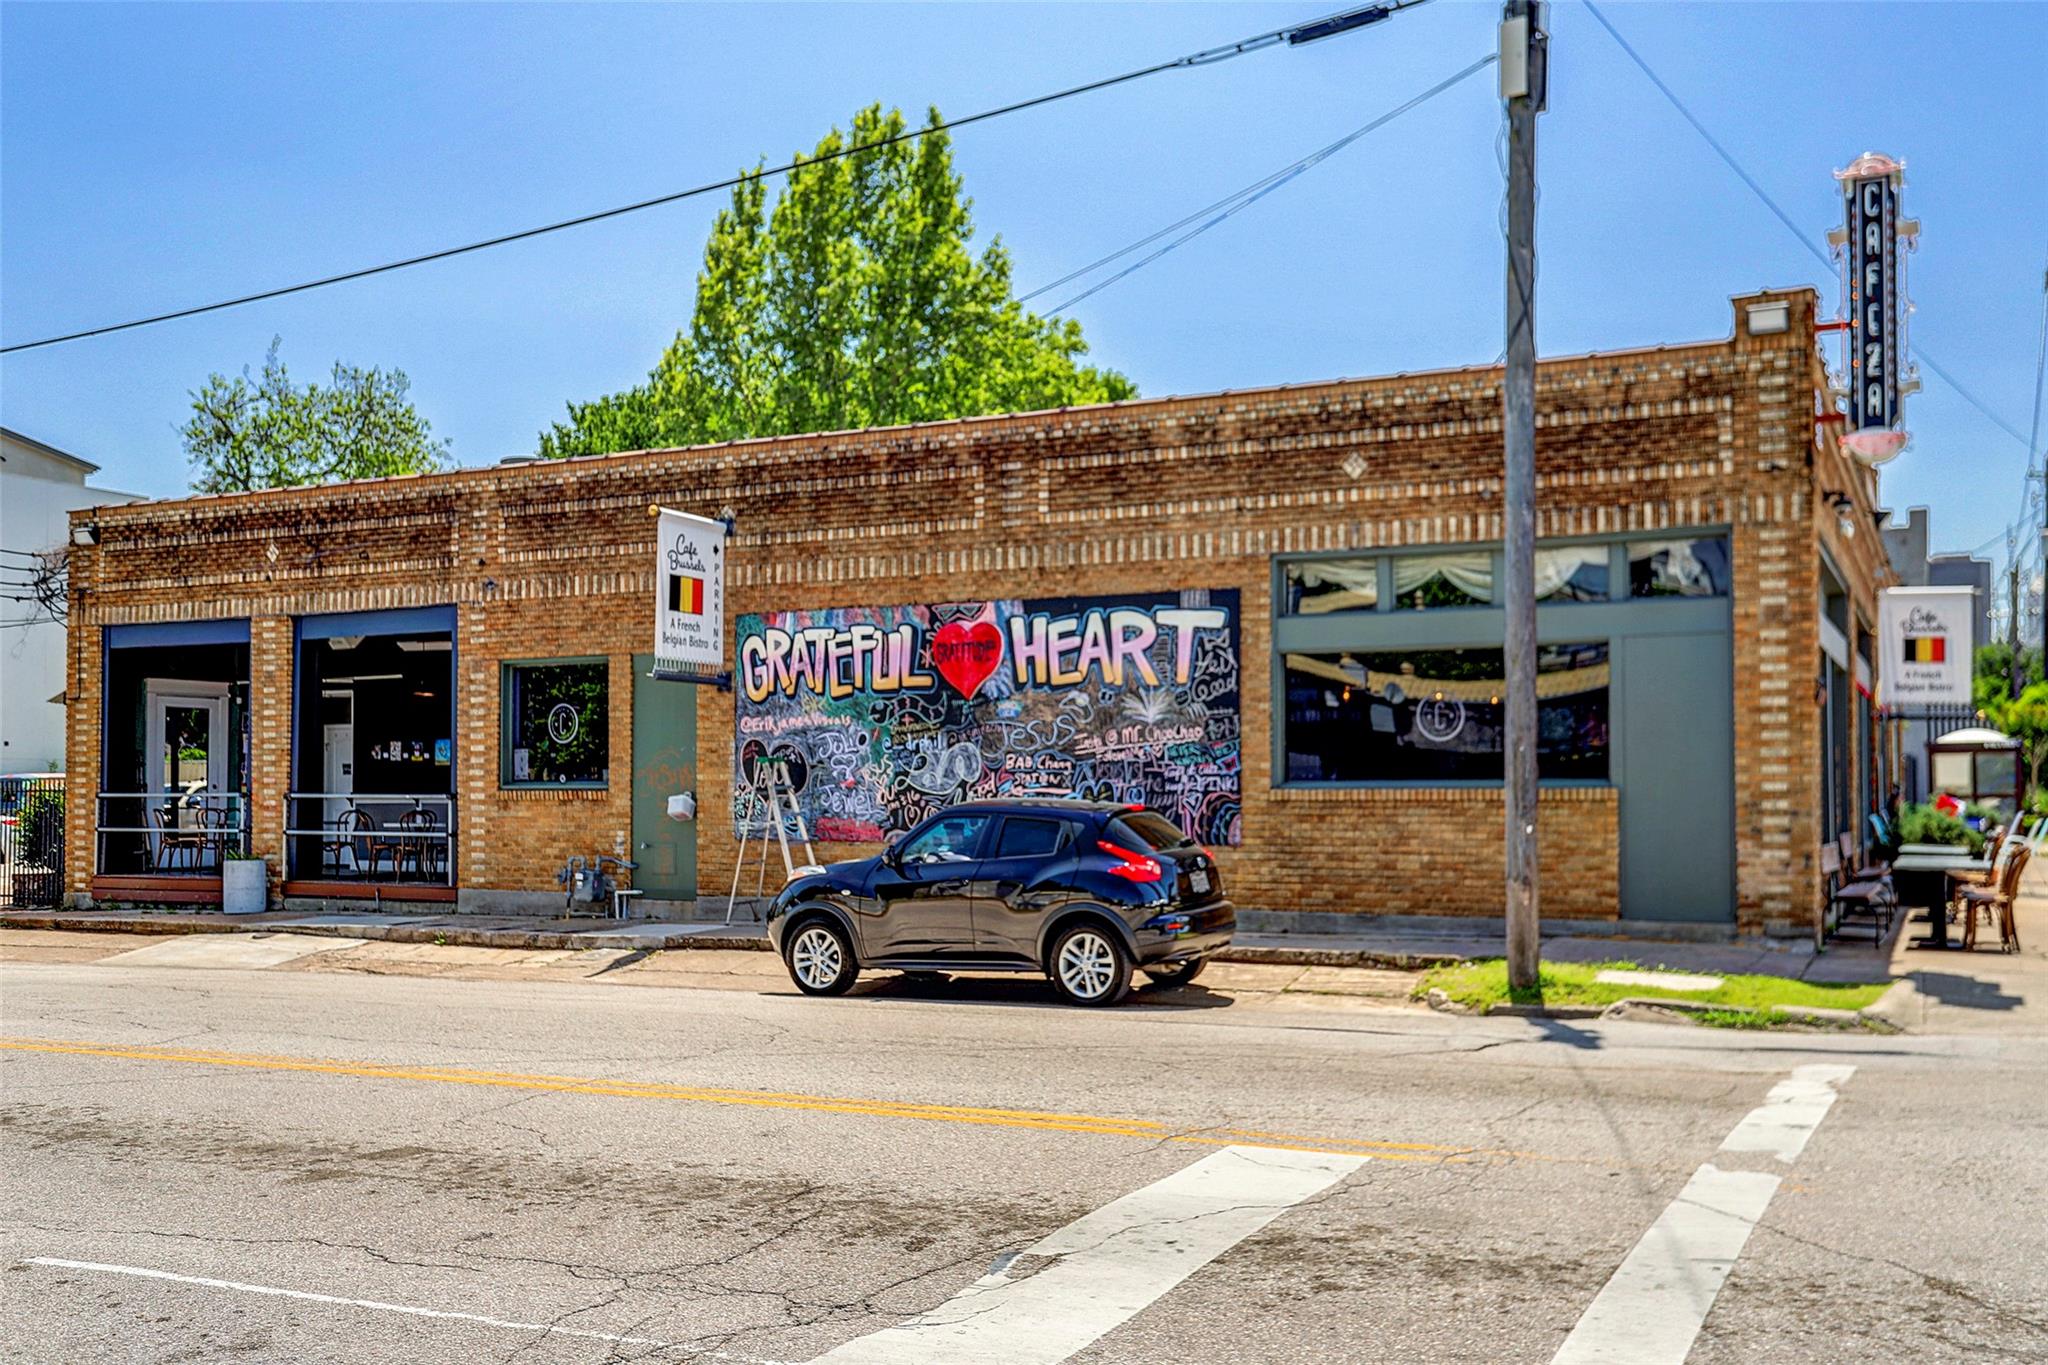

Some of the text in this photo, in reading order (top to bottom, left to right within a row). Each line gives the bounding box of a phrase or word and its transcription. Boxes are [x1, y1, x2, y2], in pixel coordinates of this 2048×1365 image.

[676, 533, 698, 560] Cafe
[667, 549, 706, 573] Brussels
[670, 618, 701, 633] A French
[662, 631, 709, 650] Belgian Bistro
[742, 609, 1227, 703] GRATEFUL HEART
